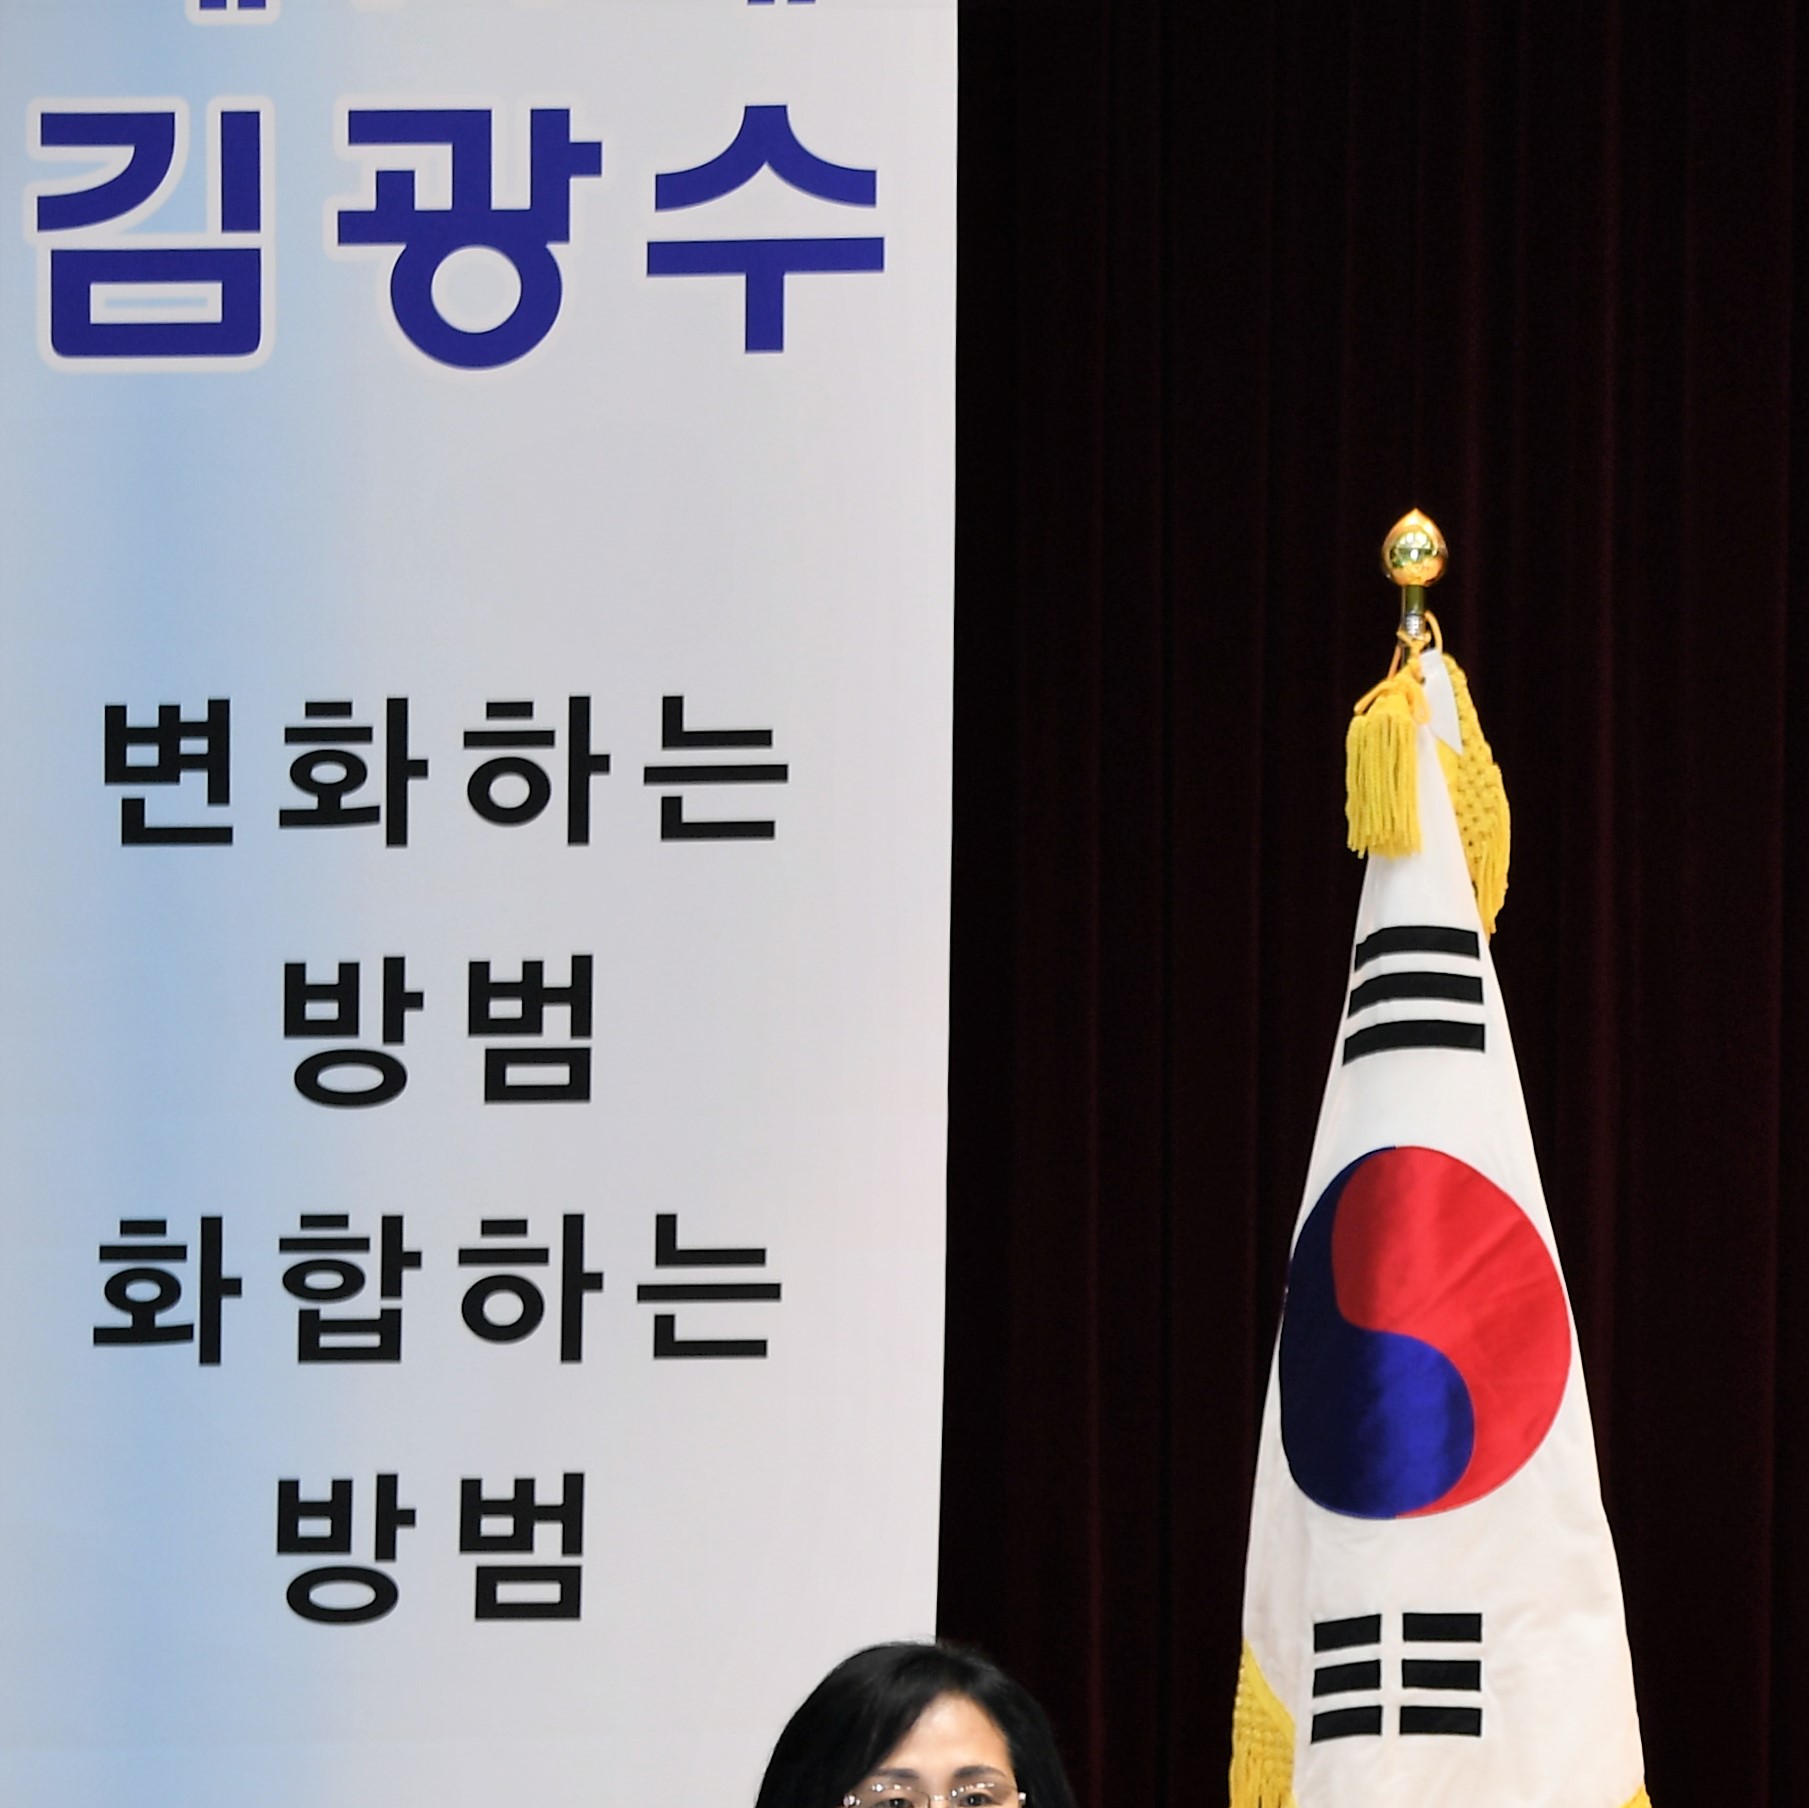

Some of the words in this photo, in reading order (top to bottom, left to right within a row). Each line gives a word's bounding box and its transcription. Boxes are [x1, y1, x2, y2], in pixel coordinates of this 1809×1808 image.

[36, 104, 885, 370] 김광수
[104, 695, 789, 848] 변화하는
[283, 954, 593, 1109] 방범
[92, 1213, 782, 1367] 화합하는
[276, 1472, 585, 1626] 방범
